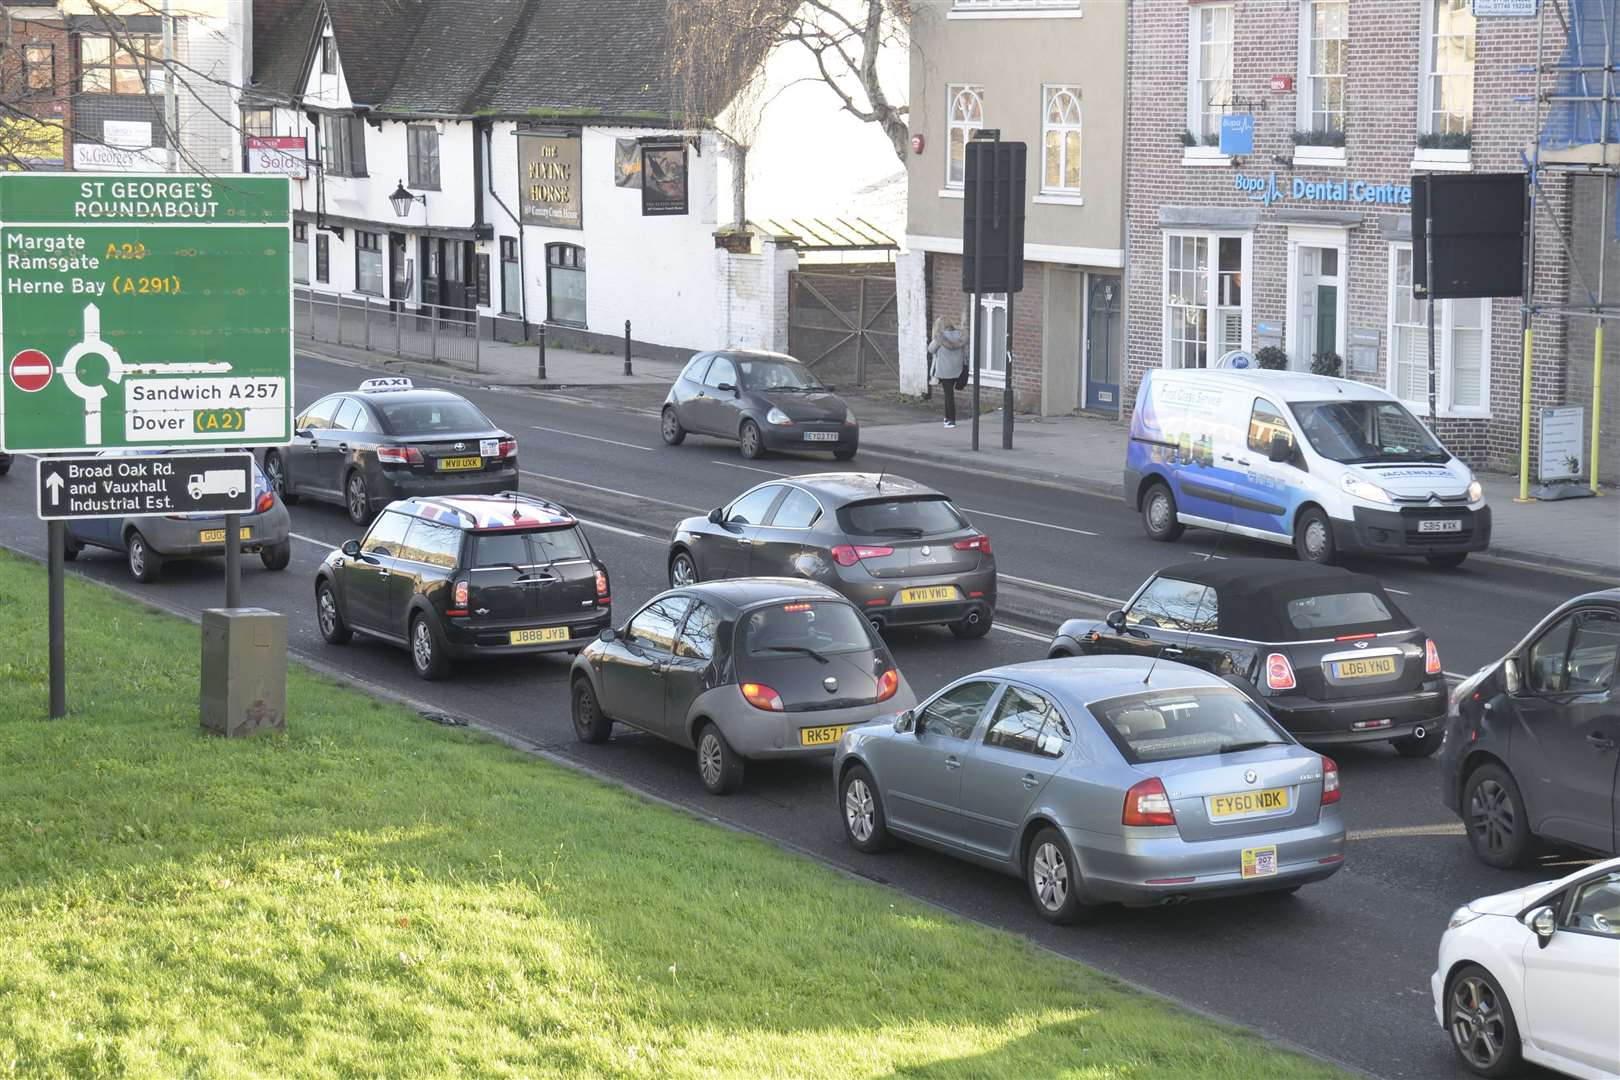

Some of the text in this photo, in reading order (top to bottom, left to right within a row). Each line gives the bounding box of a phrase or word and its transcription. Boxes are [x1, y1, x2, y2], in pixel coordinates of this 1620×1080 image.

[1222, 118, 1241, 128] Bupa
[541, 145, 558, 158] THE
[260, 154, 294, 169] Sold
[528, 160, 570, 181] FLYING
[80, 182, 213, 199] ST GEORGE'S
[531, 184, 570, 203] HORSE
[1235, 172, 1412, 204] Bupa Dental Centre
[74, 201, 219, 218] ROUNDABOUT
[7, 234, 86, 252] Margate
[7, 254, 100, 272] Ramsgate
[8, 275, 181, 296] Herne Bay (A291)
[370, 378, 408, 387] TAXI
[132, 384, 278, 401] Sandwich A257
[132, 411, 243, 432] Dover (A2)
[69, 462, 175, 478] Broad Oak Rd.
[70, 479, 167, 495] and Vauxhall
[70, 496, 175, 511] Industrial Est.
[516, 628, 565, 642] J888 JYB
[1342, 659, 1390, 676] LD61 YNO
[807, 727, 838, 743] RK57
[1216, 791, 1281, 813] FY60 NDK
[1257, 855, 1272, 864] 207
